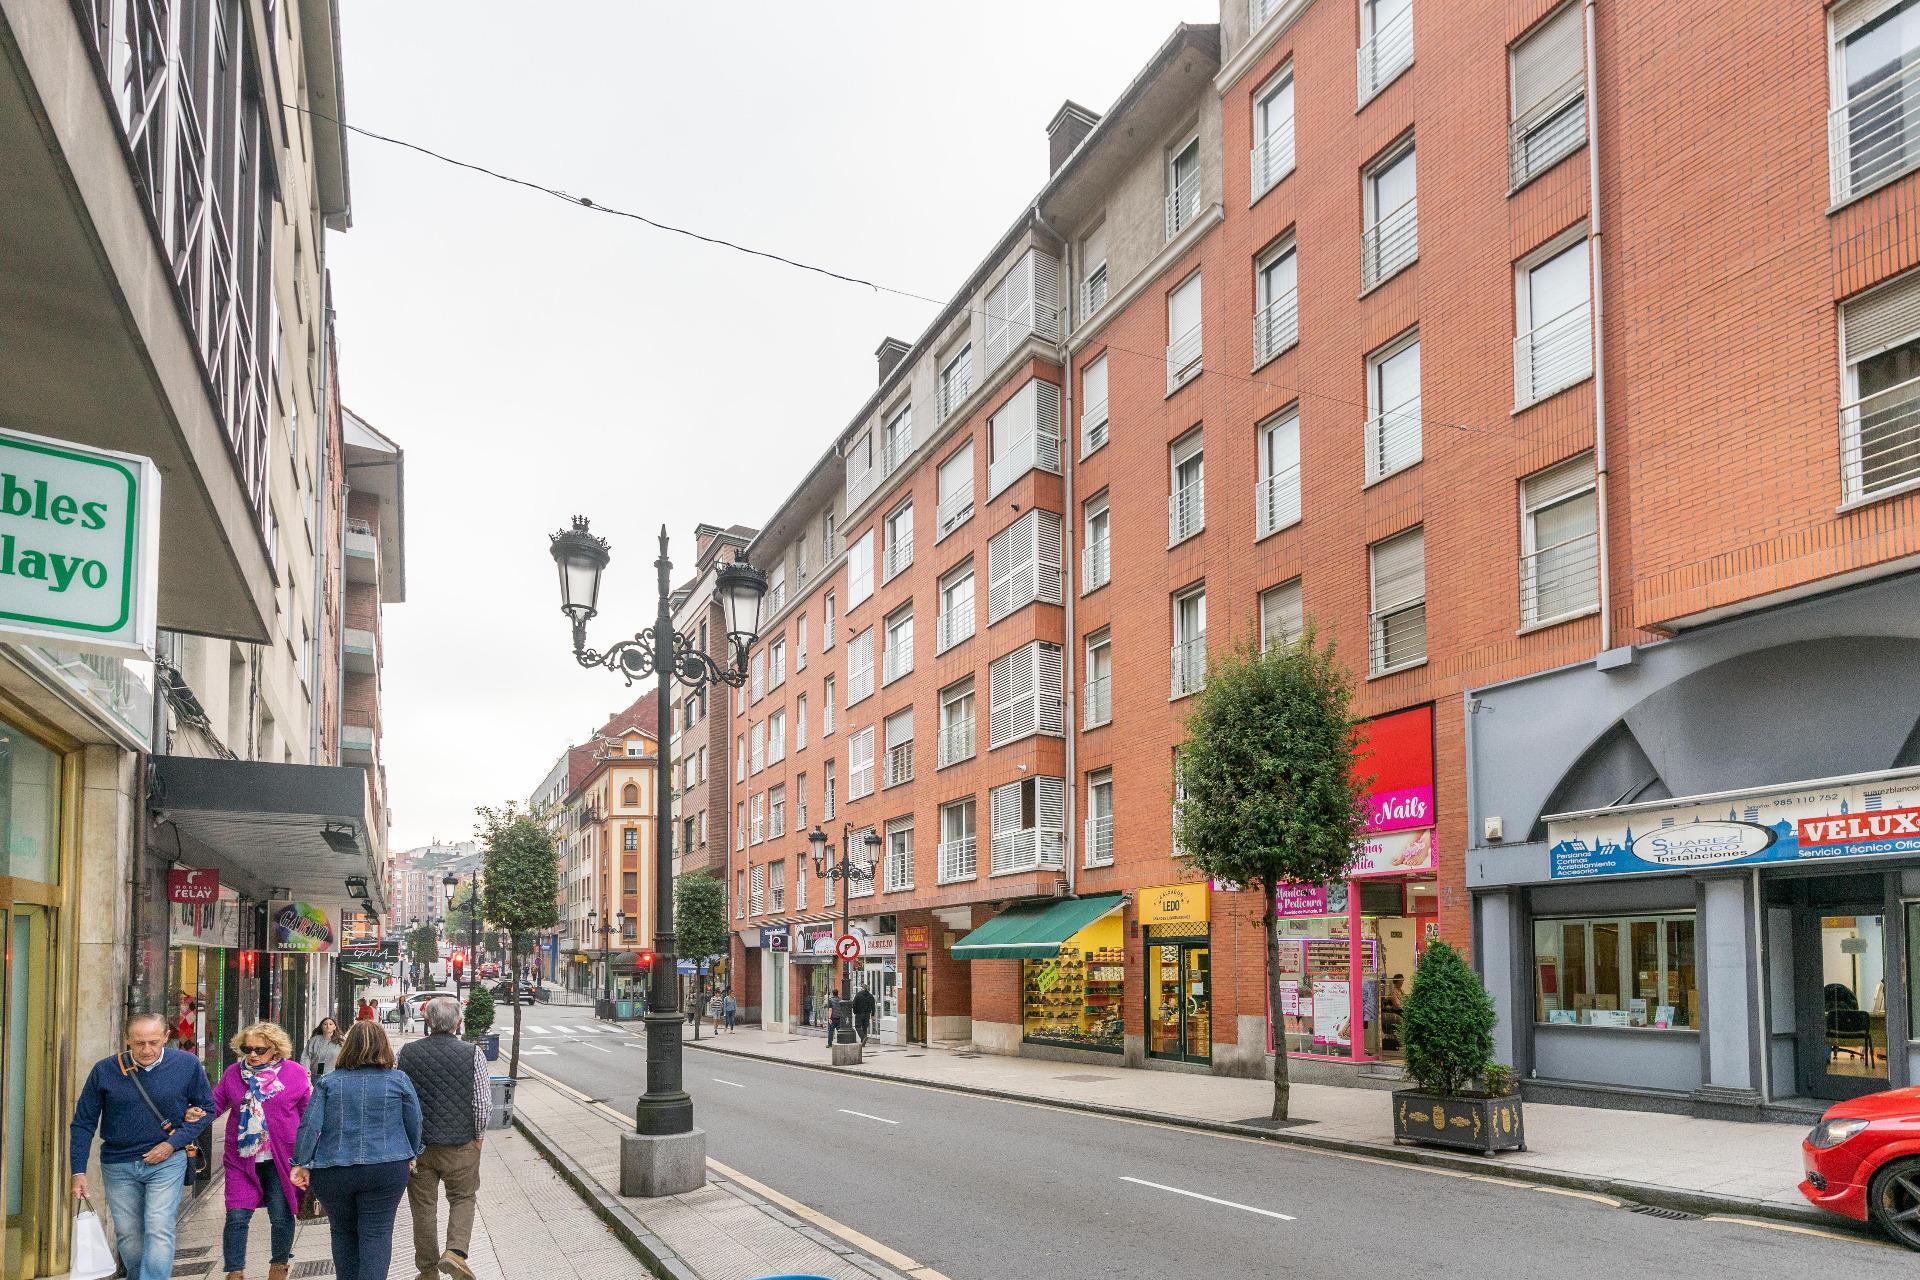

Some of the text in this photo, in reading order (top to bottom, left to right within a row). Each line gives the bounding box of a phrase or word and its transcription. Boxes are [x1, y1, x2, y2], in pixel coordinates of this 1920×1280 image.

[0, 473, 107, 530] bles
[0, 534, 107, 592] layo
[1773, 798, 1793, 807] 985
[1796, 796, 1815, 804] 110
[1819, 793, 1838, 801] 752
[1375, 797, 1427, 824] Nails
[1803, 812, 1919, 842] VELUX
[1657, 850, 1748, 862] Instalaciones
[1798, 848, 1841, 858] Servicio
[1846, 844, 1892, 854] Técnico
[1556, 861, 1616, 870] Acristalamiento
[1557, 868, 1598, 876] Accesorios
[1163, 900, 1180, 911] LEDO
[1284, 898, 1322, 908] Pedicura
